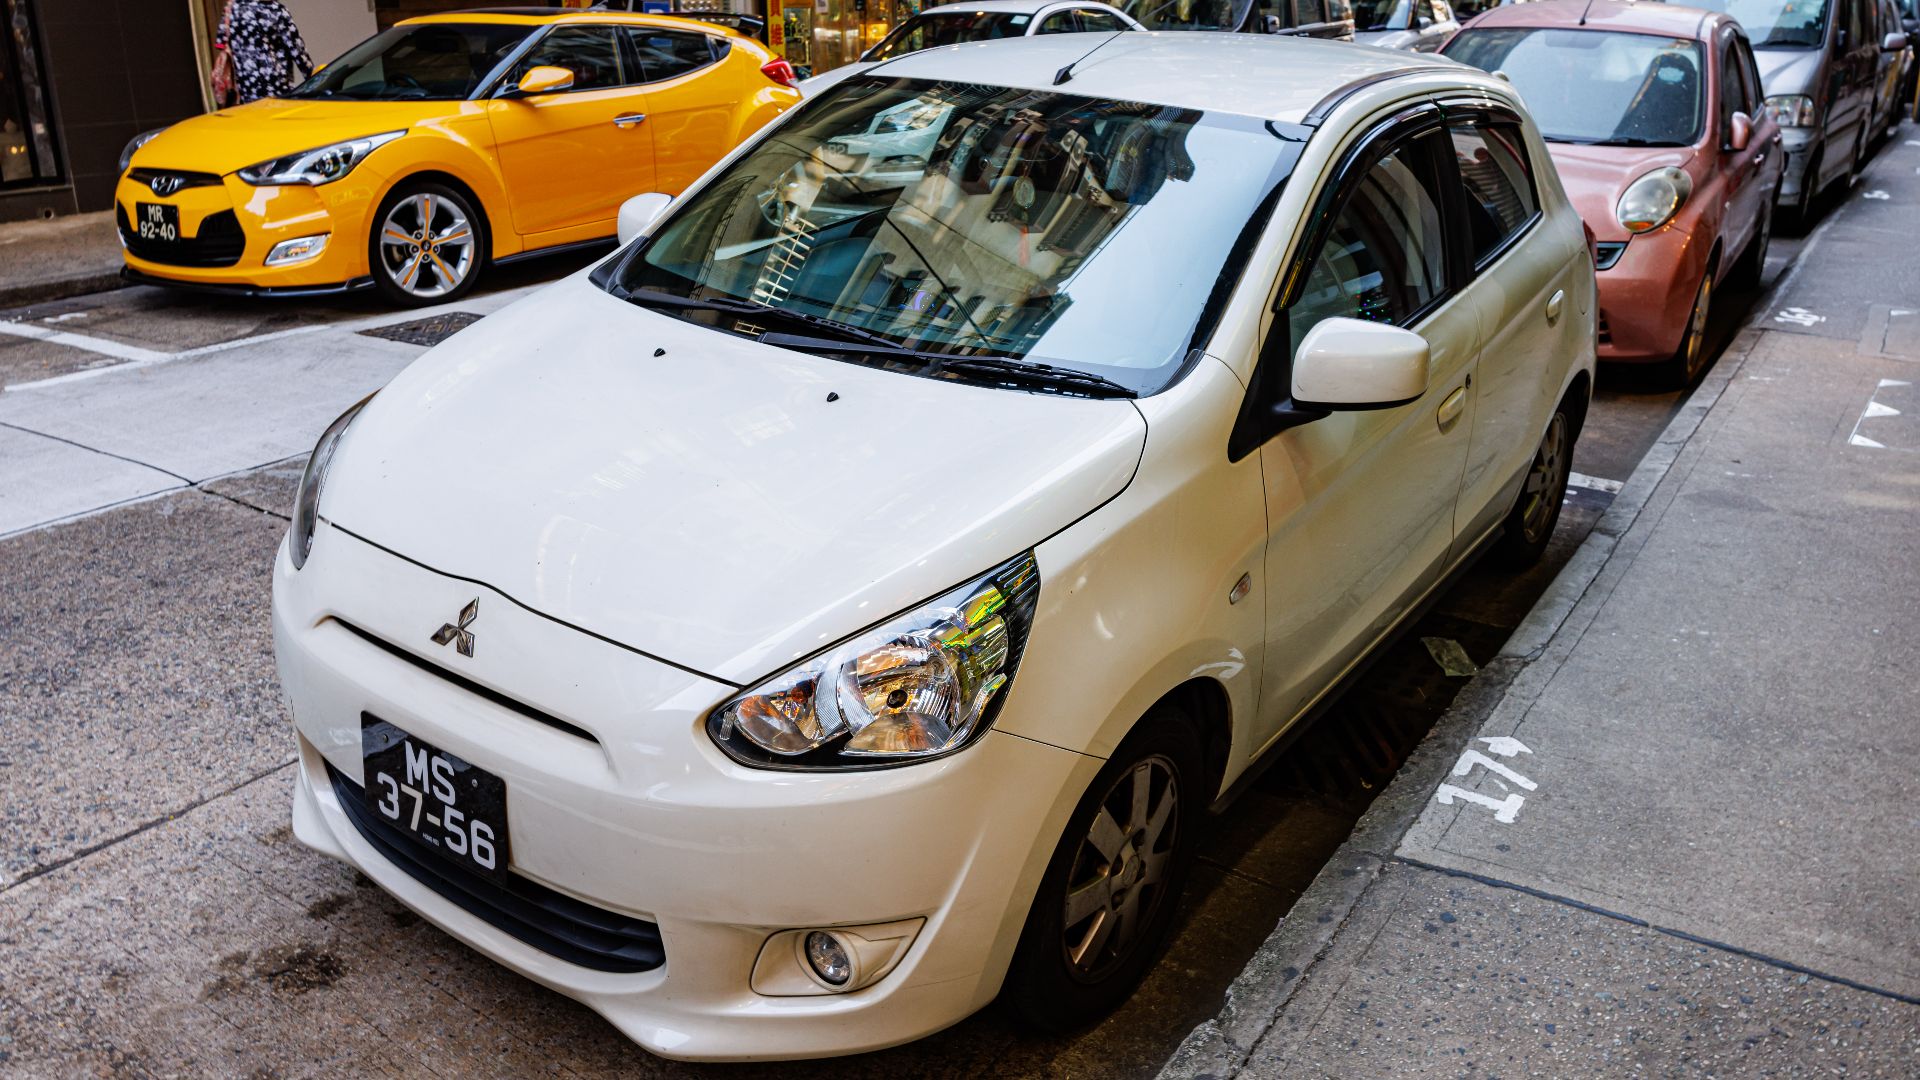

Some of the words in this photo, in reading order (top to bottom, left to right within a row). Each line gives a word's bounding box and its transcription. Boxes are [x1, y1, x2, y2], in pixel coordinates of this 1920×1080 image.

[140, 220, 176, 241] 92-40
[147, 204, 164, 223] MR
[405, 740, 456, 806] MS
[1437, 749, 1538, 823] 17
[377, 772, 496, 870] 37-56
